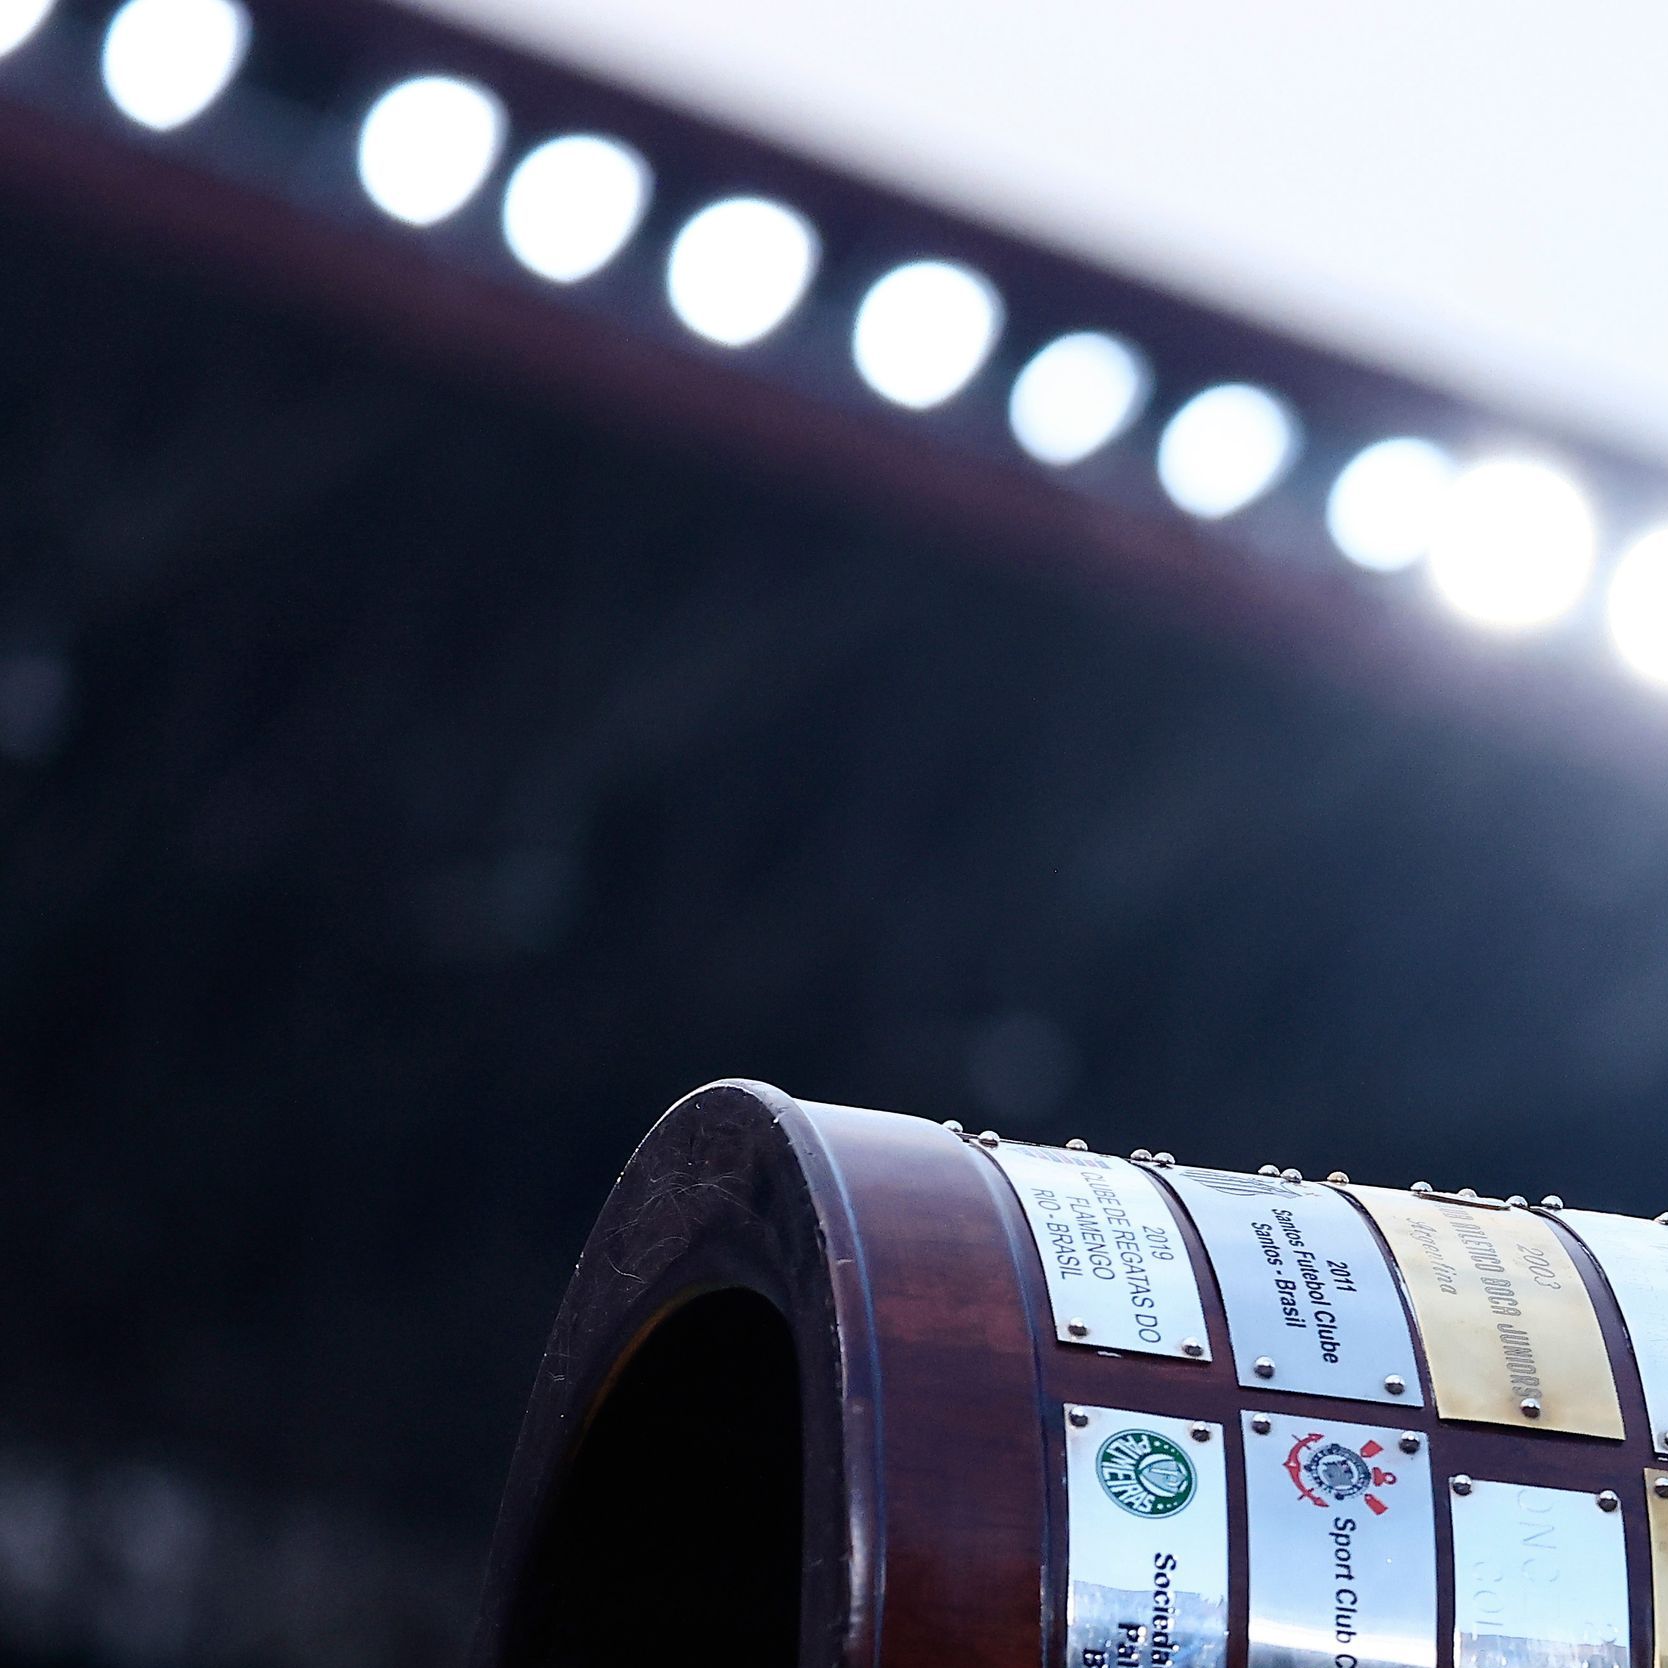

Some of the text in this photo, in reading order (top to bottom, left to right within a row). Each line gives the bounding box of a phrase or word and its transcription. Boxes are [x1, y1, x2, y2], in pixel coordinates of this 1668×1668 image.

[1031, 1187, 1060, 1211] RIO
[1046, 1222, 1083, 1280] BRASIL
[1066, 1195, 1116, 1280] FLAMENGO
[1080, 1171, 1161, 1343] CLUBE DE REGATAS DO
[1142, 1225, 1174, 1261] 2019
[1450, 1221, 1505, 1273] ATLETICO
[1516, 1243, 1561, 1290] 2003
[1251, 1222, 1283, 1266] Santos
[1275, 1279, 1307, 1328] Brasil
[1271, 1208, 1341, 1364] Santos Futebol Clube
[1326, 1260, 1357, 1293] 2011
[1481, 1276, 1521, 1317] BOCA
[1497, 1323, 1542, 1400] JUNIORS
[1102, 1433, 1155, 1513] PALMEIRAS
[1329, 1516, 1356, 1581] Sport
[1335, 1588, 1358, 1644] Club
